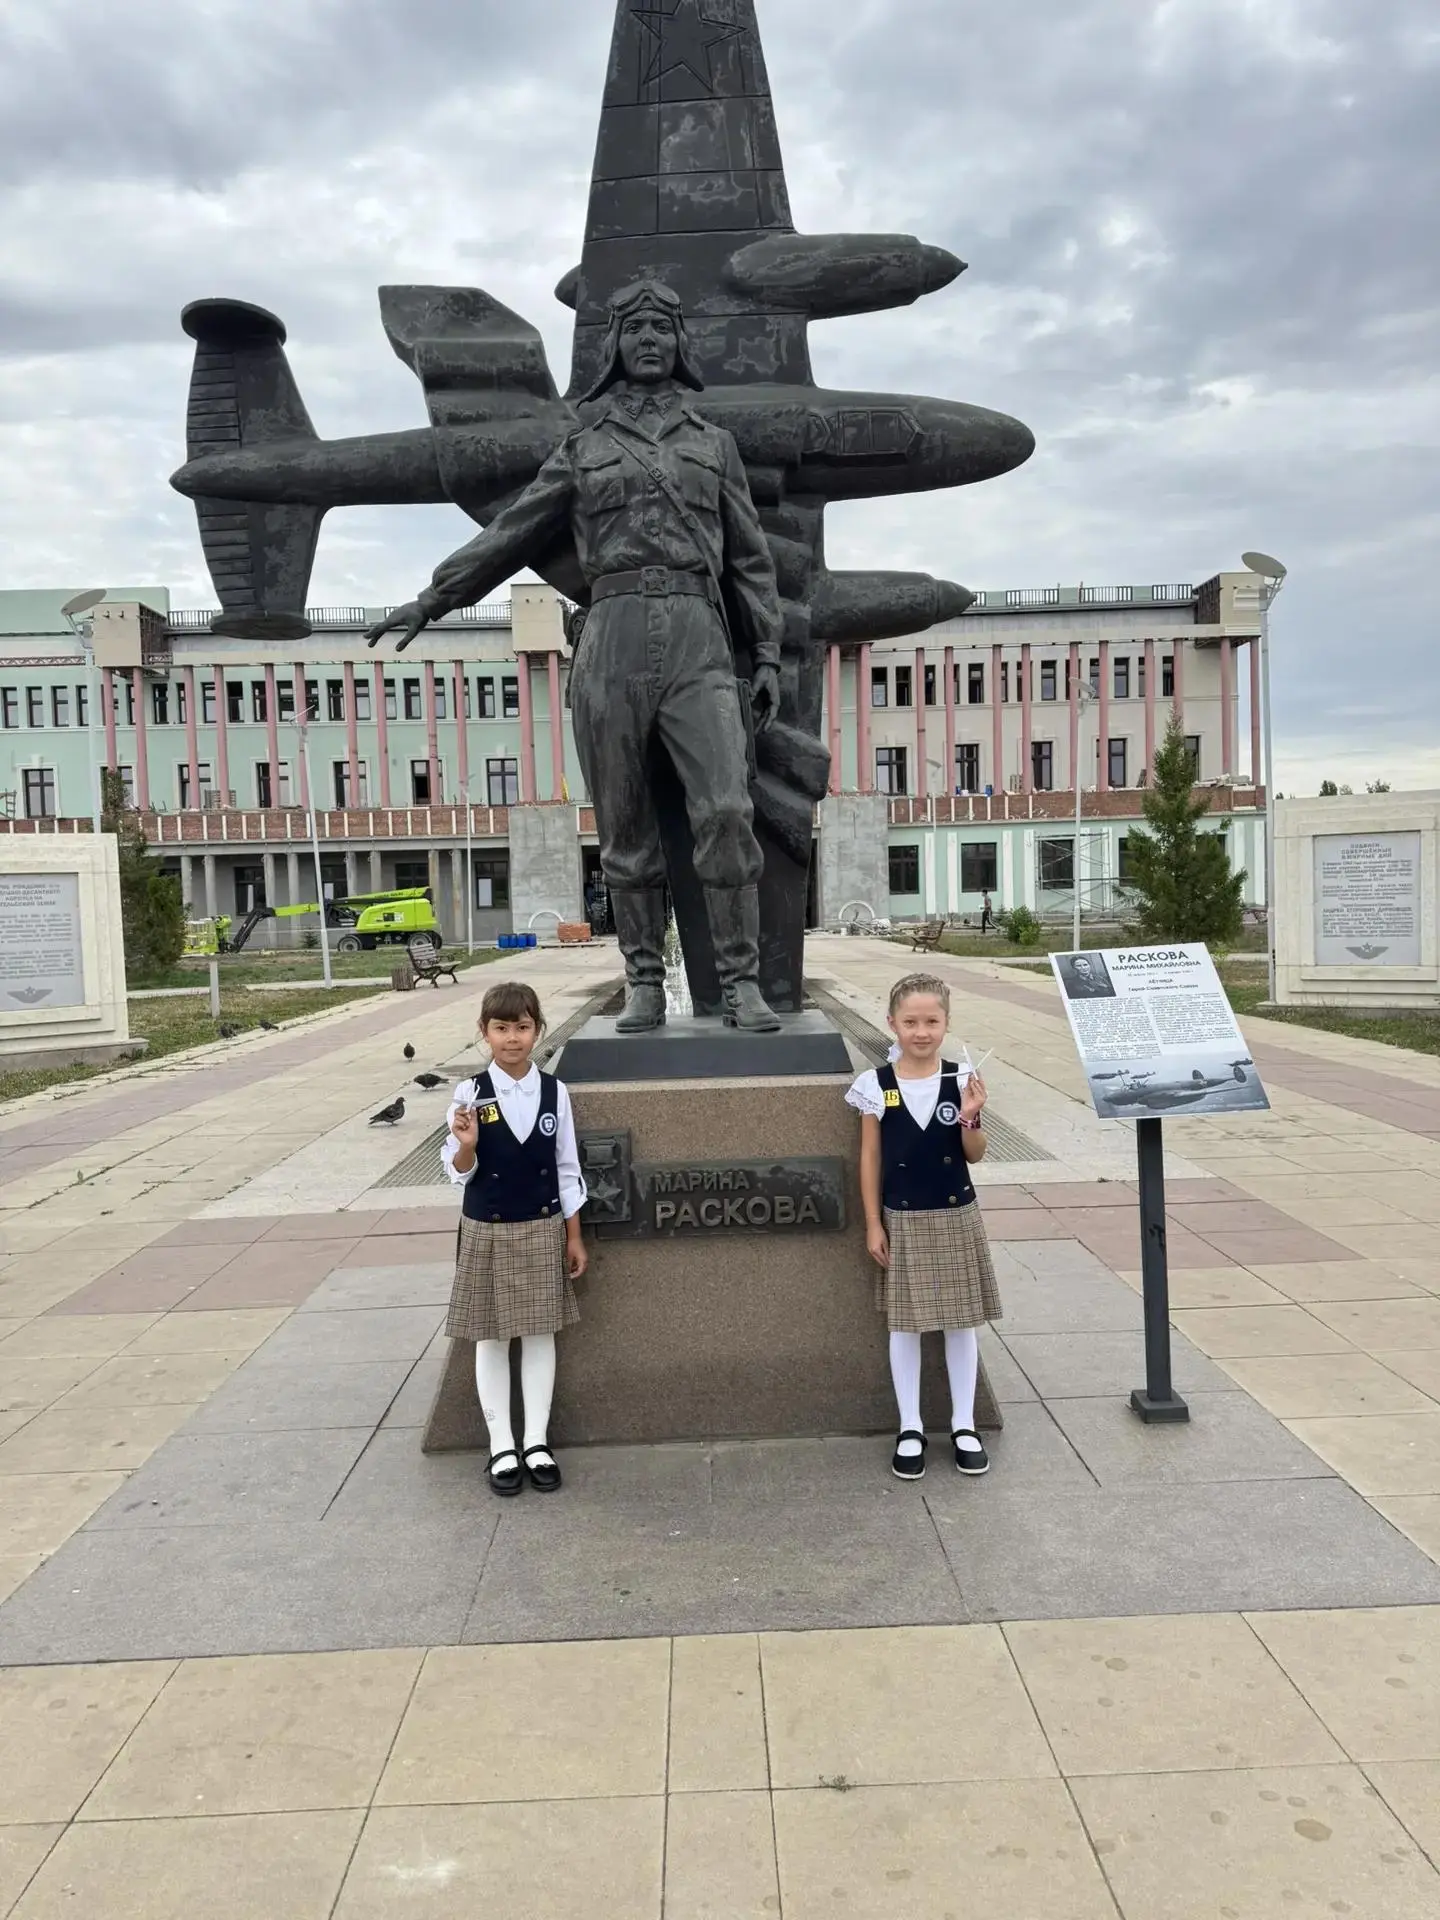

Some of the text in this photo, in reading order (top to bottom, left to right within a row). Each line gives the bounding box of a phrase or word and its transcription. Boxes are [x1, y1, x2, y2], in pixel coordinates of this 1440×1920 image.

[1118, 950, 1189, 963] РАСКОВА
[1146, 960, 1201, 969] МИХАЙЛОВНА
[654, 1170, 750, 1193] МАРИНА
[655, 1195, 821, 1229] РАСКОВА
